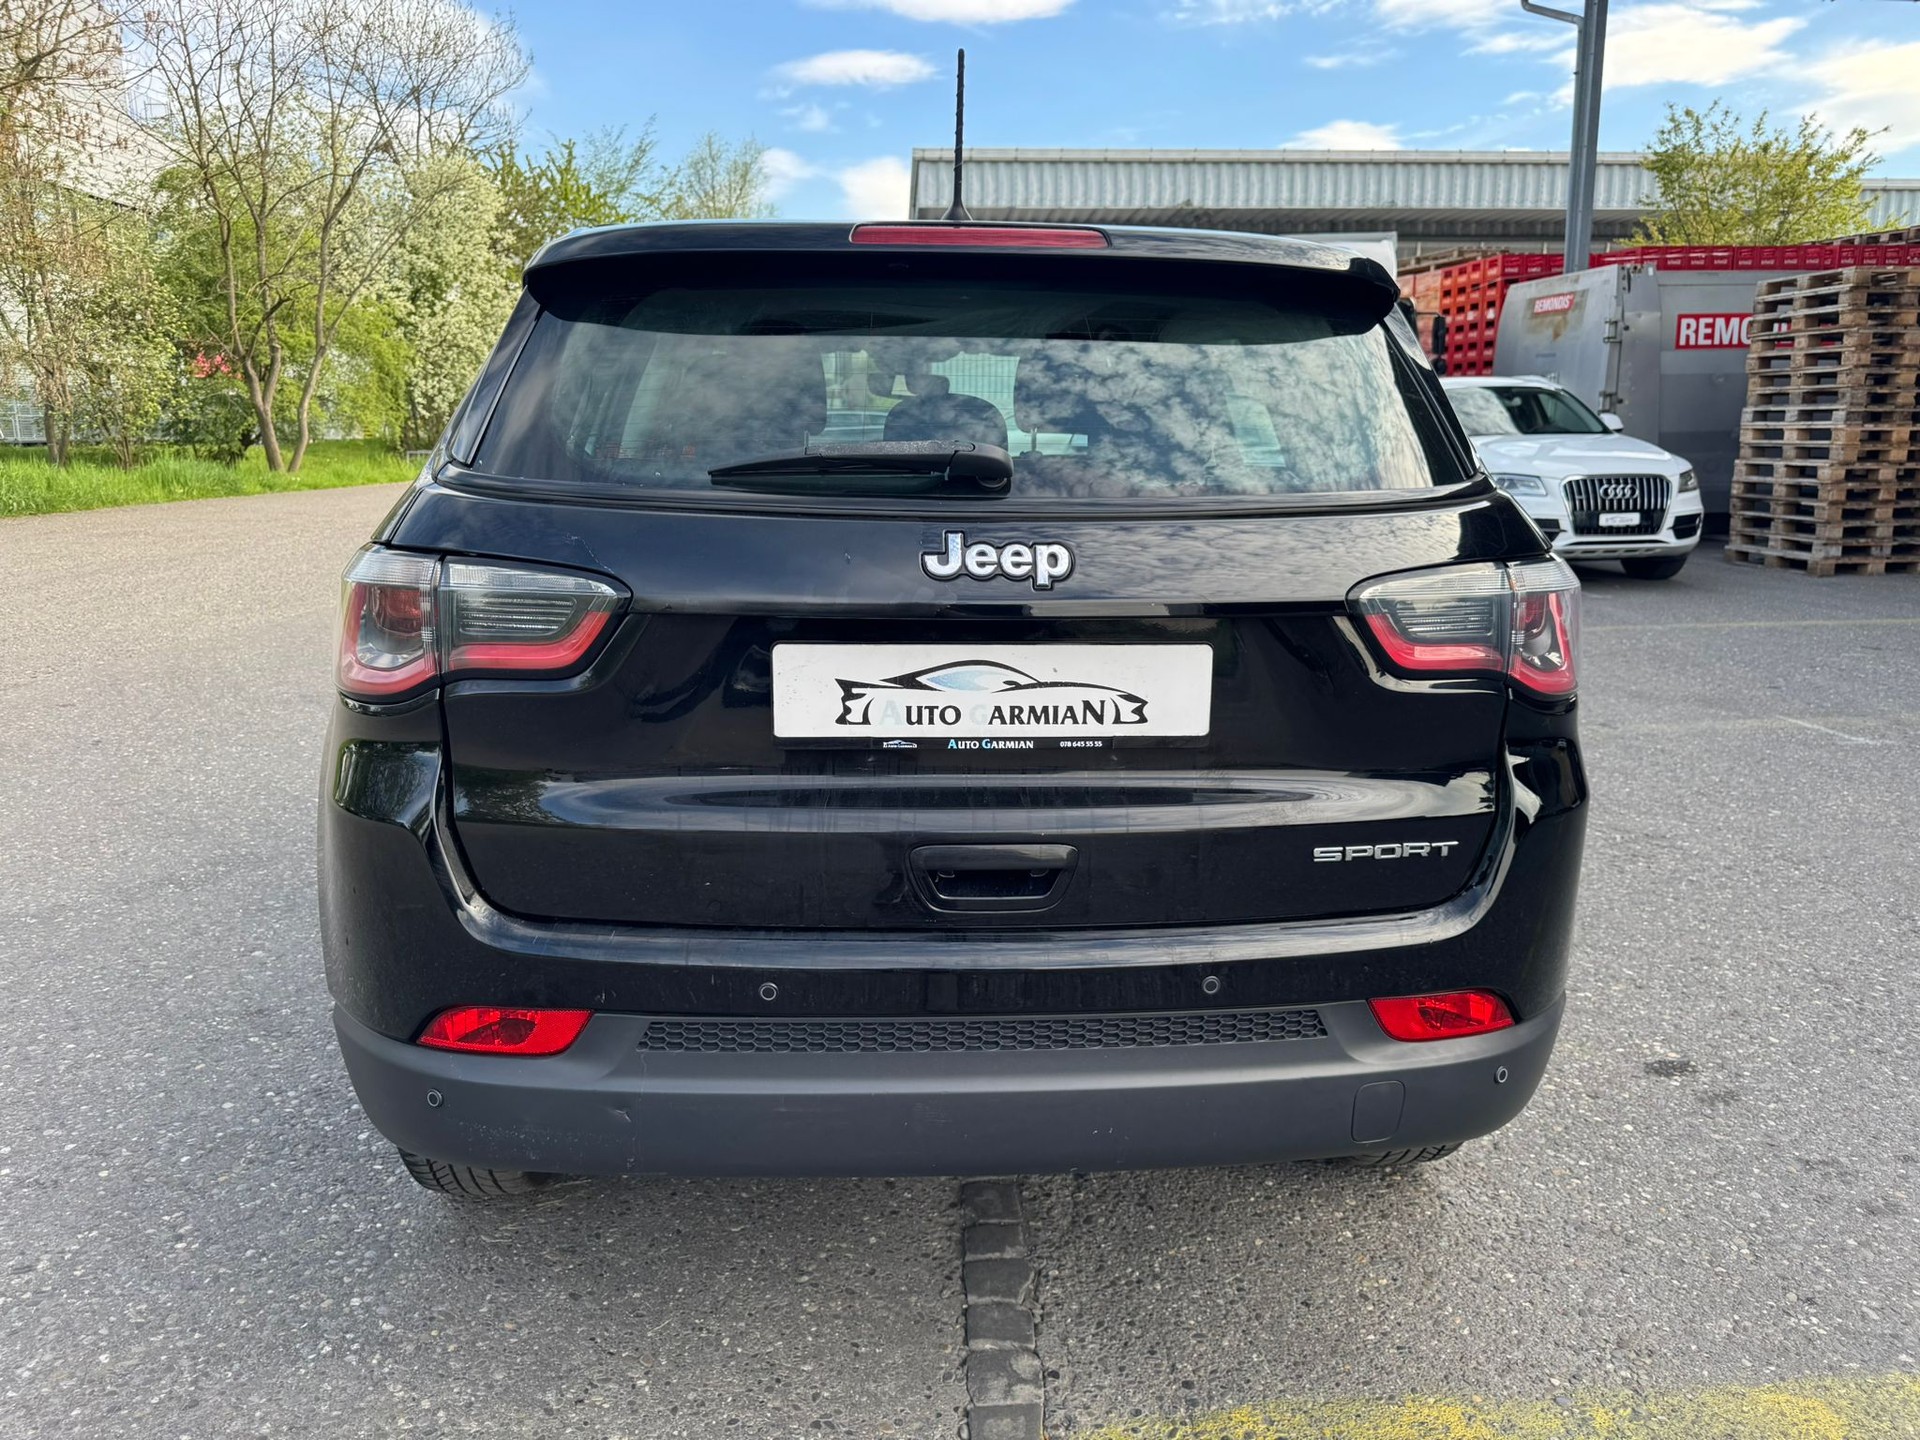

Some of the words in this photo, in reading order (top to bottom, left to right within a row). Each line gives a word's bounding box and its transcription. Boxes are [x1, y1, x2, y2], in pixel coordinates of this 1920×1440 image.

[923, 532, 1072, 588] Jeep
[879, 699, 962, 726] AUTO
[968, 699, 1106, 726] GARMIAN
[947, 738, 980, 749] AUTO
[981, 738, 1034, 749] GARMIAN
[1313, 840, 1459, 862] SPORT
